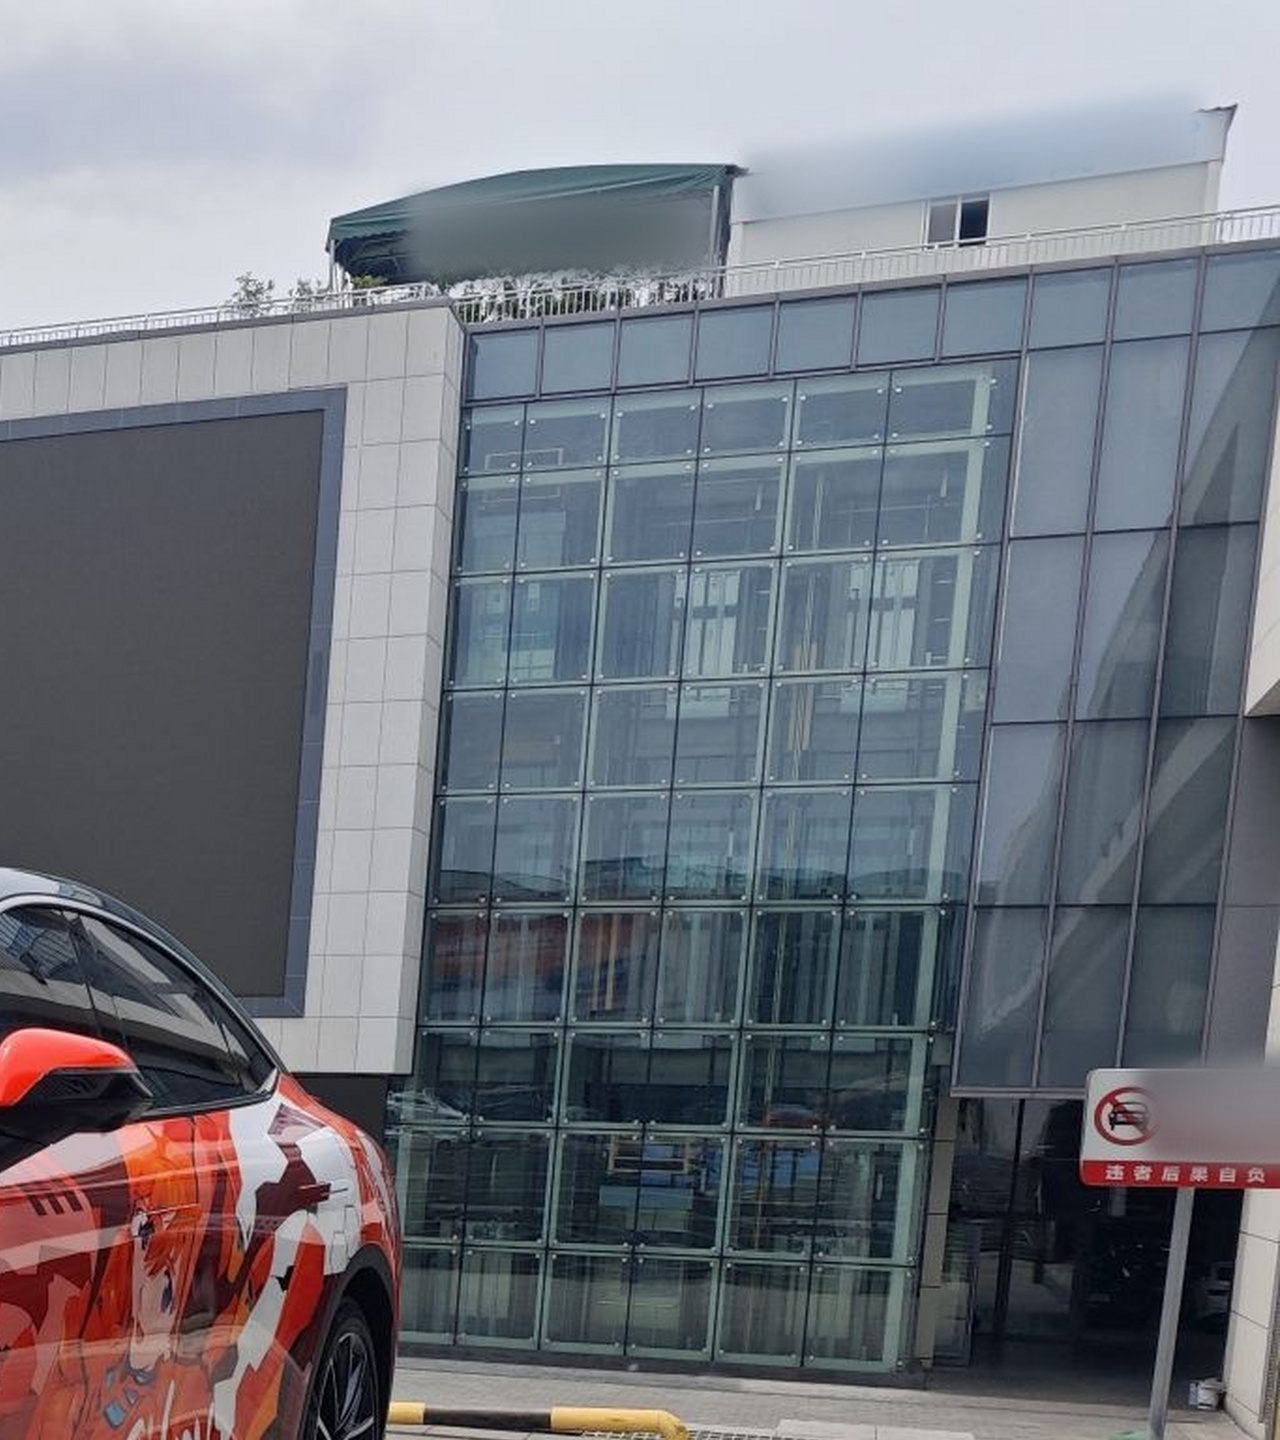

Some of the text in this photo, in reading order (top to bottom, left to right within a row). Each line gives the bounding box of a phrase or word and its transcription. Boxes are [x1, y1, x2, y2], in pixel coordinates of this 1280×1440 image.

[1104, 1164, 1267, 1184] 违者后果自负
